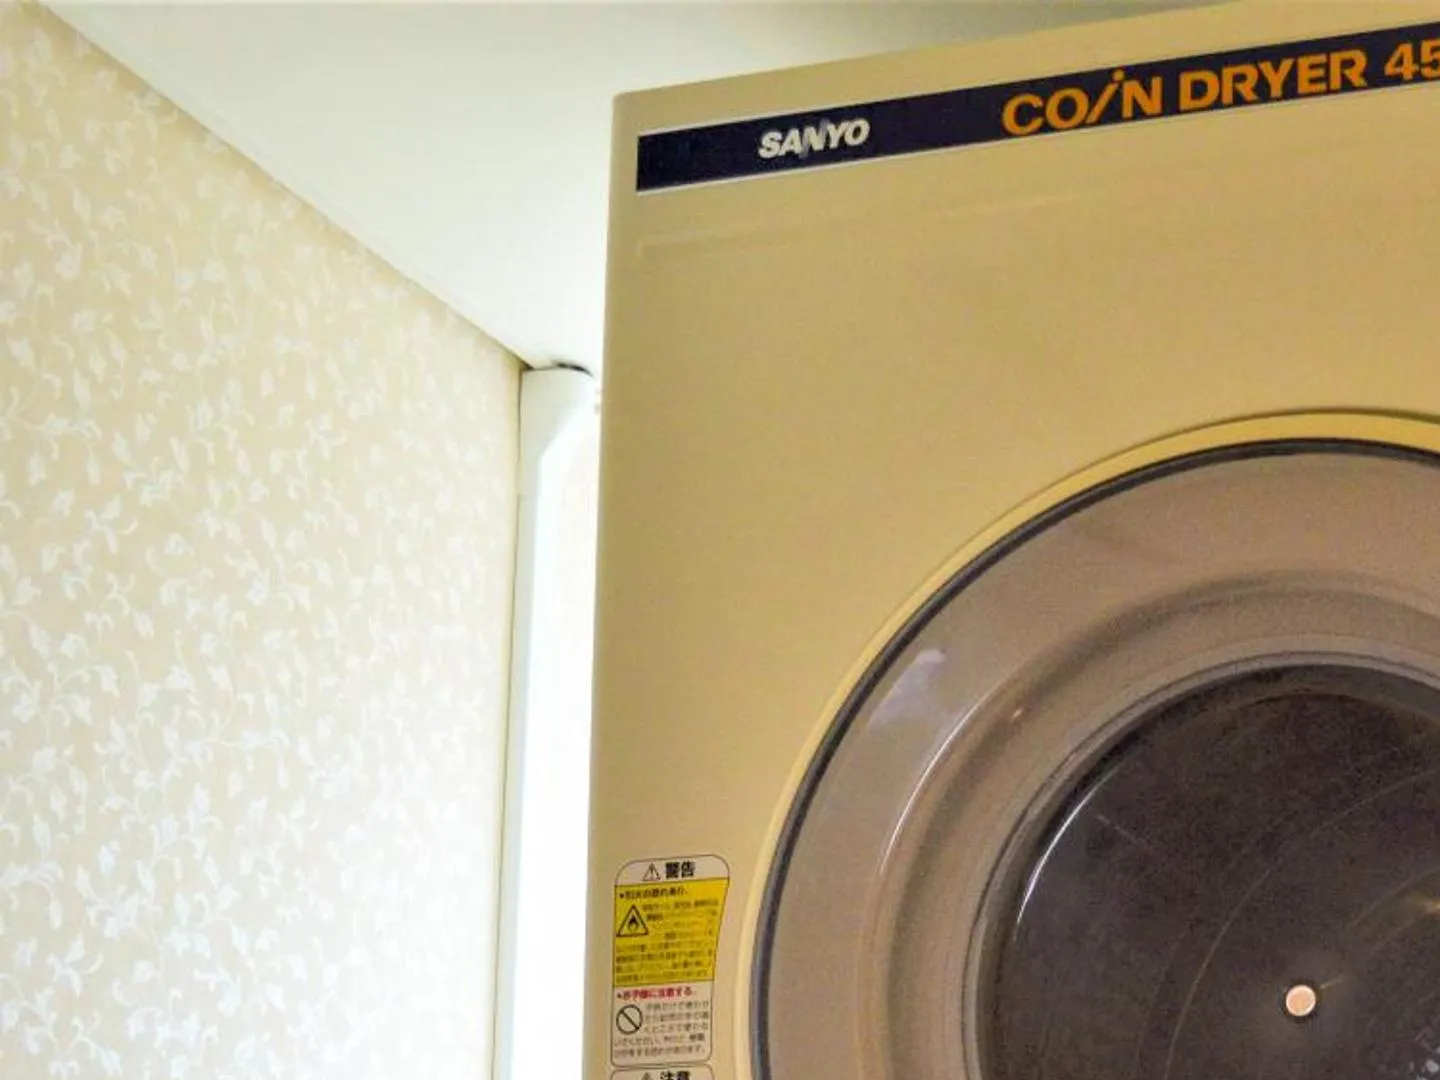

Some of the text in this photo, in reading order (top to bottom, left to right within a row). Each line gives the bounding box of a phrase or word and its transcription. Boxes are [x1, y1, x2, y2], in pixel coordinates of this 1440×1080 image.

[1179, 49, 1367, 112] DRYER
[758, 118, 870, 159] SANYO
[665, 860, 695, 879] 警告
